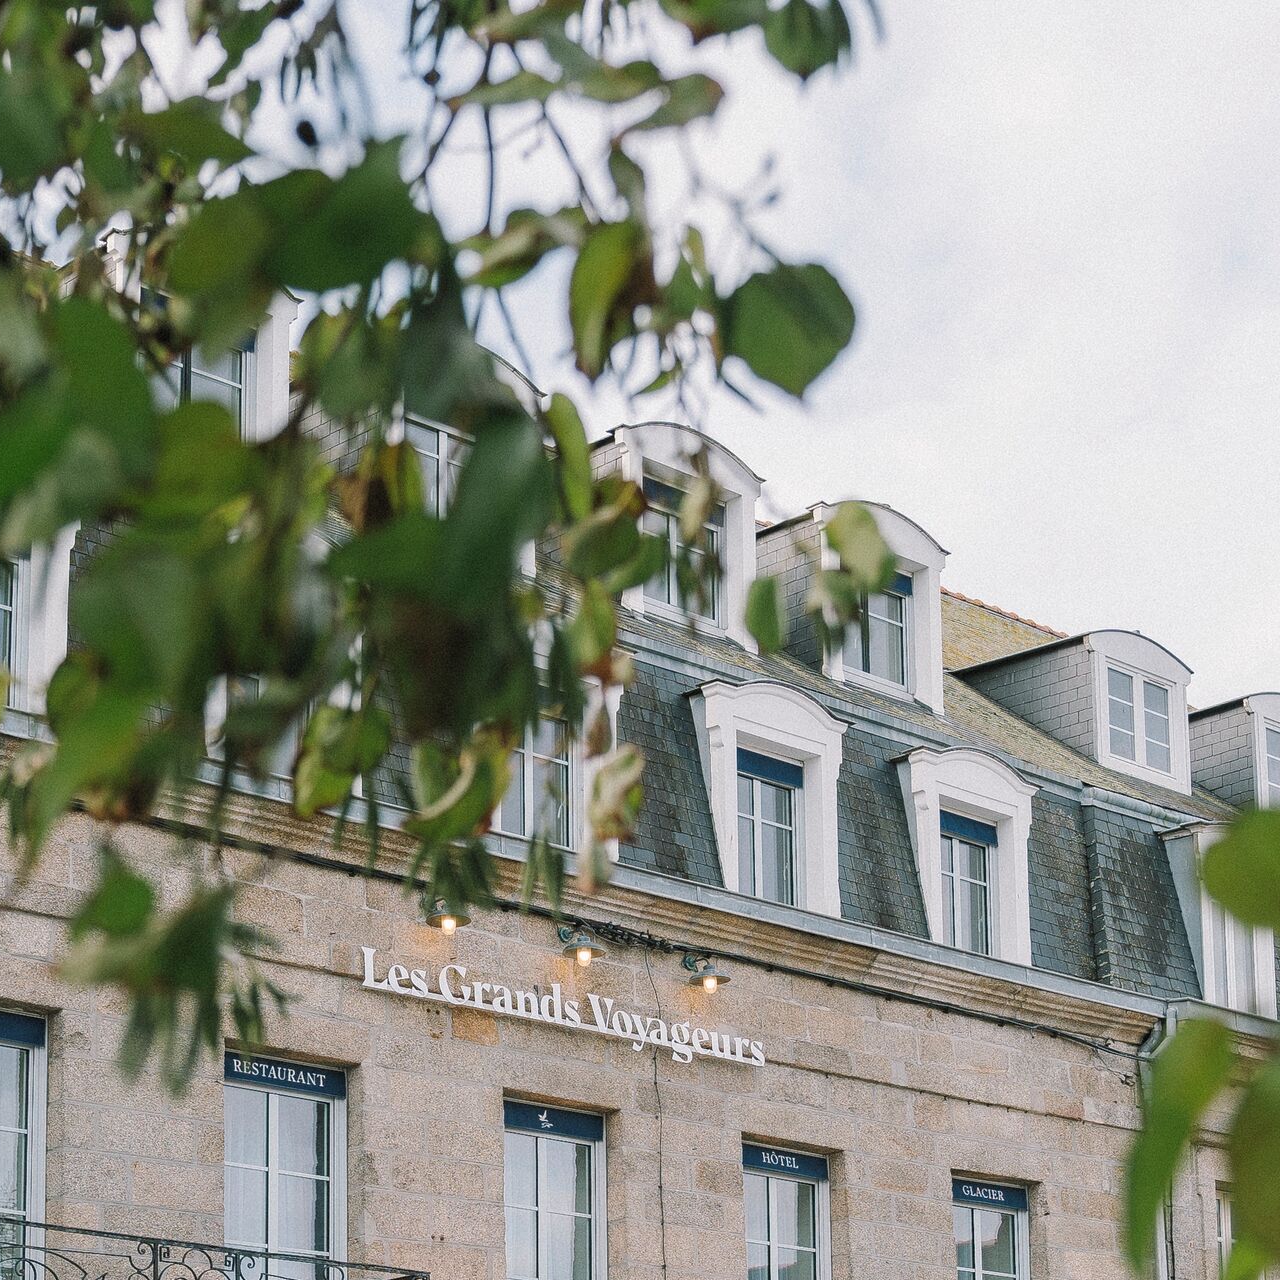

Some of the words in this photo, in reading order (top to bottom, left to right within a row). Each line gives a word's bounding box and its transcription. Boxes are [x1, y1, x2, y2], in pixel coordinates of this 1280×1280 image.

[361, 945, 429, 998] Les
[438, 964, 582, 1028] Grands
[587, 992, 766, 1067] Voyageurs
[232, 1058, 326, 1087] RESTAURANT
[761, 1151, 799, 1169] HÔTEL
[962, 1185, 1005, 1201] GLACIER
